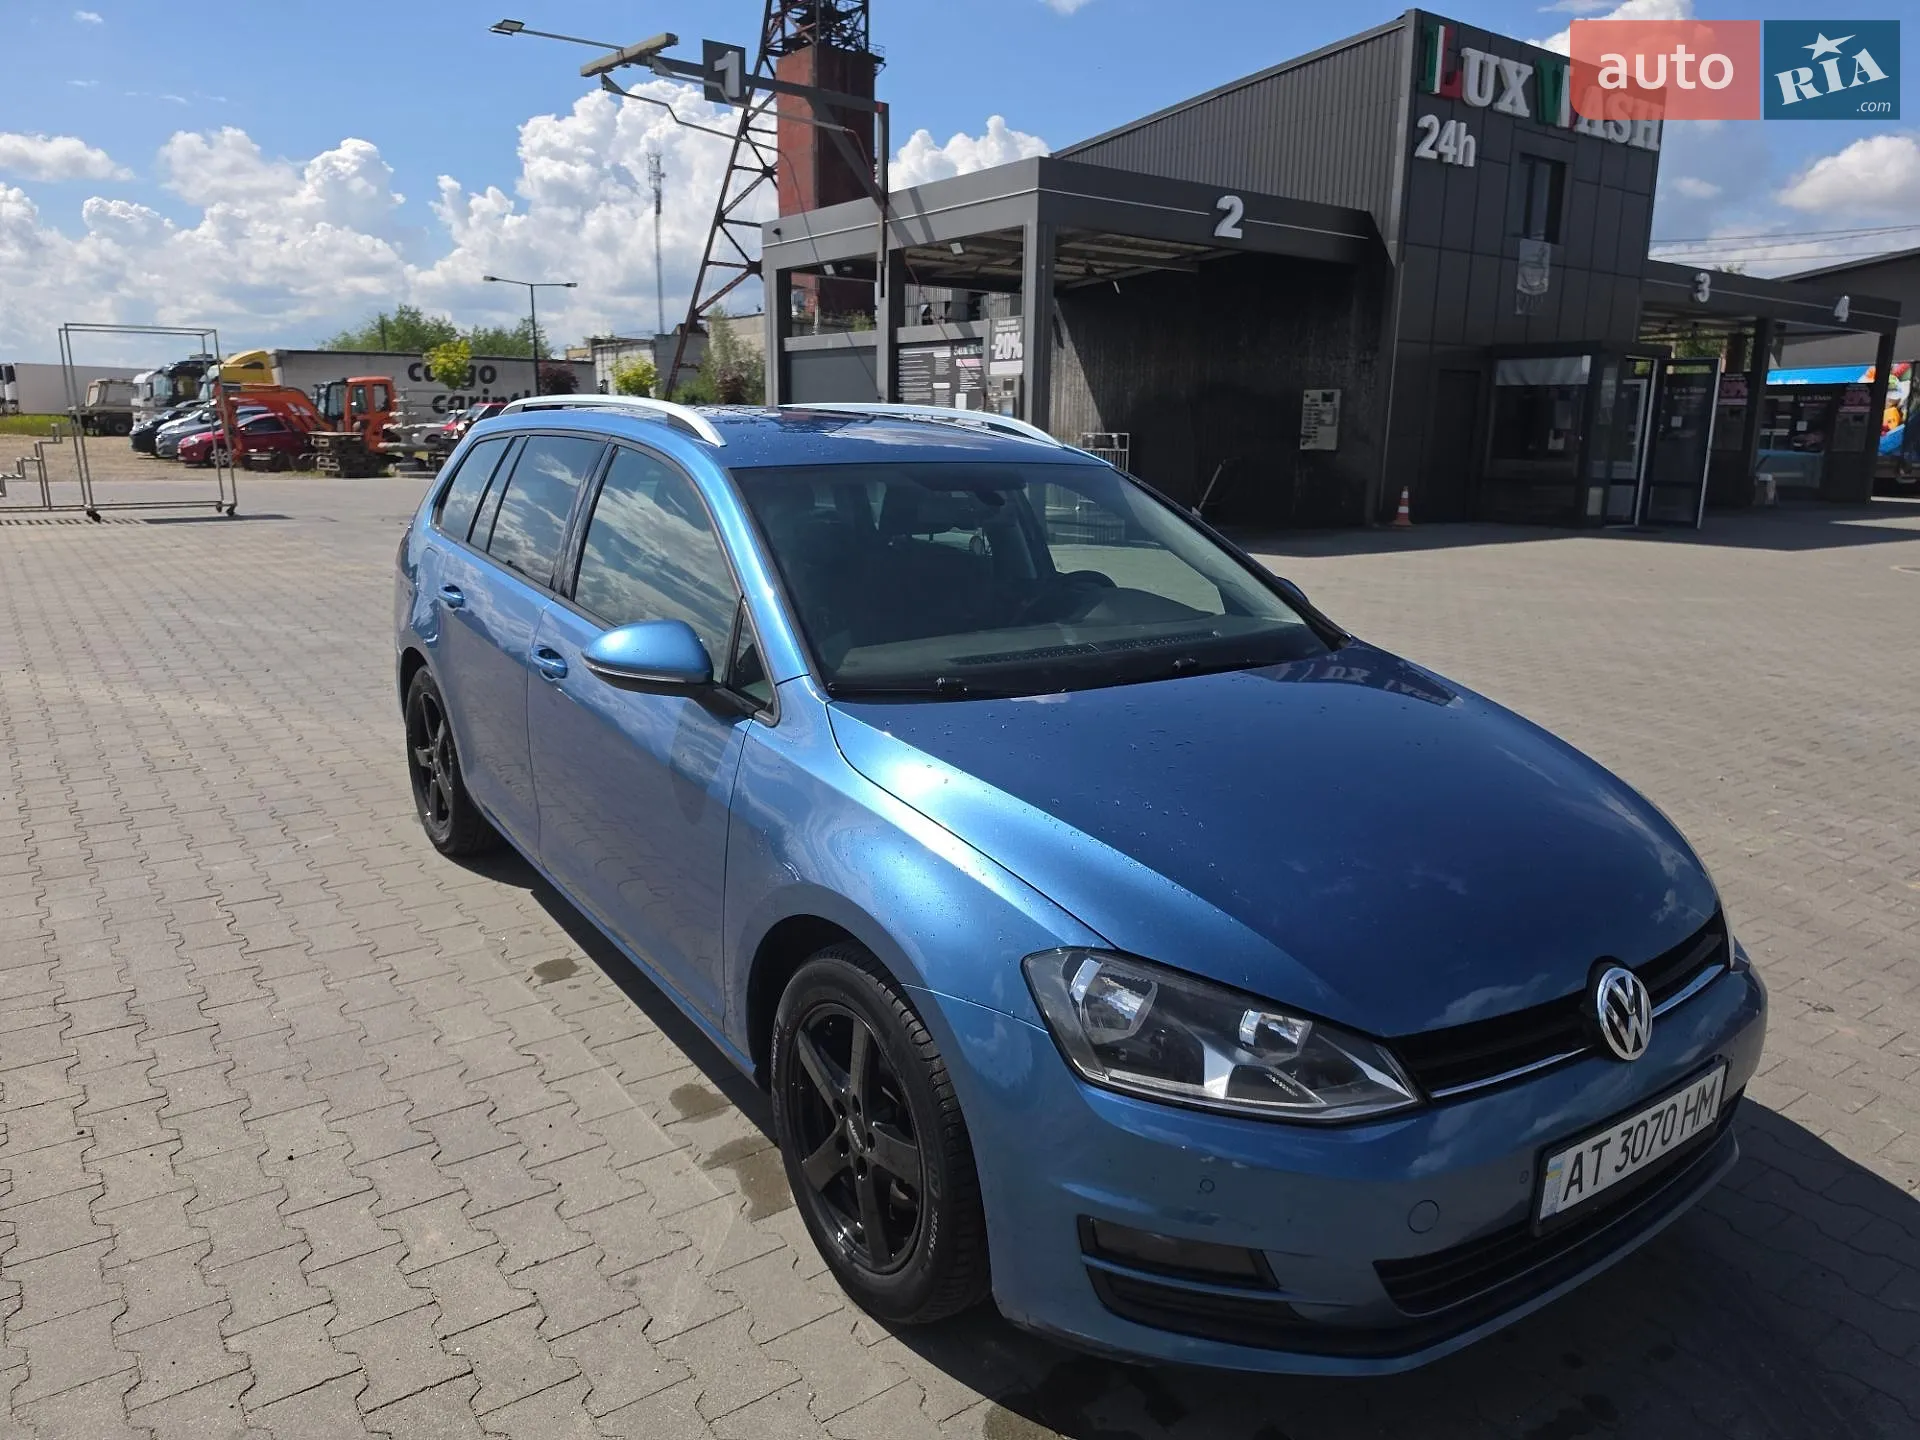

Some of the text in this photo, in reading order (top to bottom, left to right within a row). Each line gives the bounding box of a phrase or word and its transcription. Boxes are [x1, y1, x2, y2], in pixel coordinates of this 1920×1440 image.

[713, 51, 740, 98] 1
[1418, 24, 1534, 119] LUX
[1414, 114, 1477, 168] 24h
[1214, 195, 1244, 239] 2
[1694, 272, 1711, 302] 3
[1834, 295, 1850, 322] 4
[1563, 1138, 1611, 1202] AT
[1614, 1103, 1678, 1173] 3070
[1680, 1076, 1718, 1136] HM
